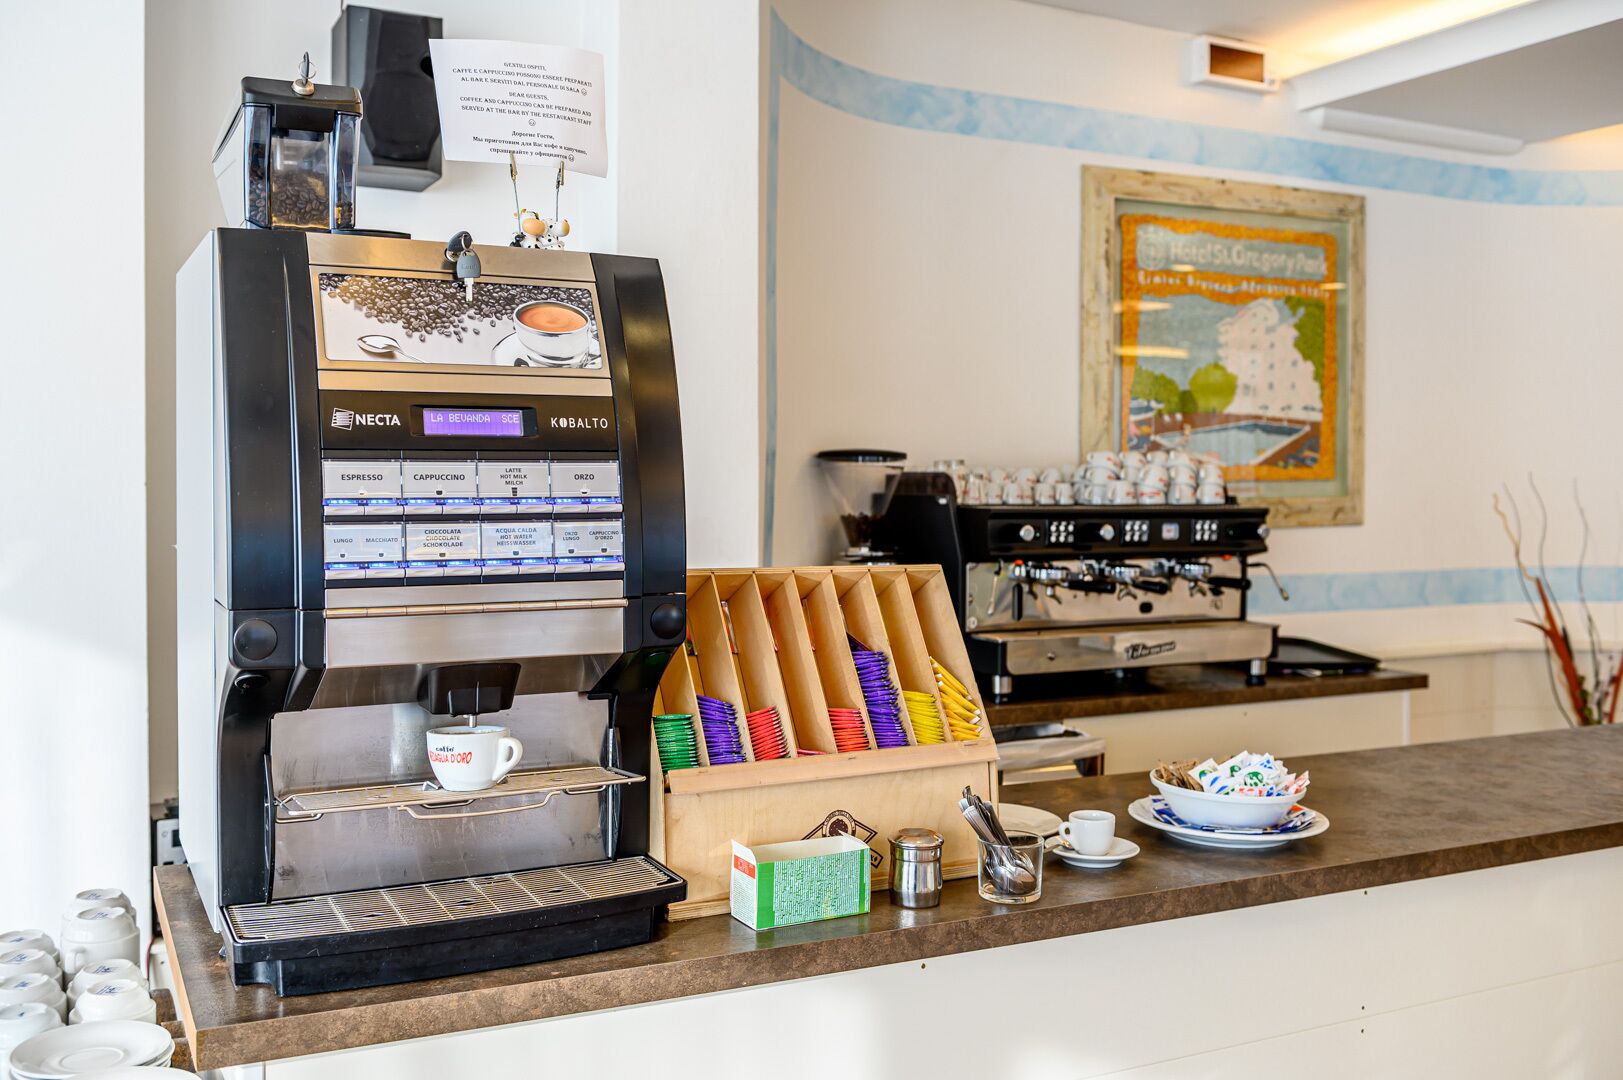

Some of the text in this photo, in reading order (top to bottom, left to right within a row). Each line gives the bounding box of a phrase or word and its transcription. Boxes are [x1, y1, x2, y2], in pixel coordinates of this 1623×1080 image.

[478, 68, 516, 77] CAPPUCCINO
[525, 81, 560, 90] PERSONALE
[496, 99, 533, 108] CAPPUCCINO
[554, 104, 582, 115] PREPARED
[576, 118, 592, 126] STAFF
[484, 138, 520, 146] приготовим
[355, 413, 401, 426] NECTA
[430, 412, 520, 424] LA BEVANDA SCE
[550, 416, 609, 429] KOBALTO
[341, 473, 384, 481] ESPRESSO
[413, 473, 466, 482] CAPPUCCINO
[573, 473, 595, 481] ORZO
[495, 527, 516, 535] ACQUA
[425, 534, 461, 542] CHOCOLATE
[450, 751, 473, 765] D'ORO
